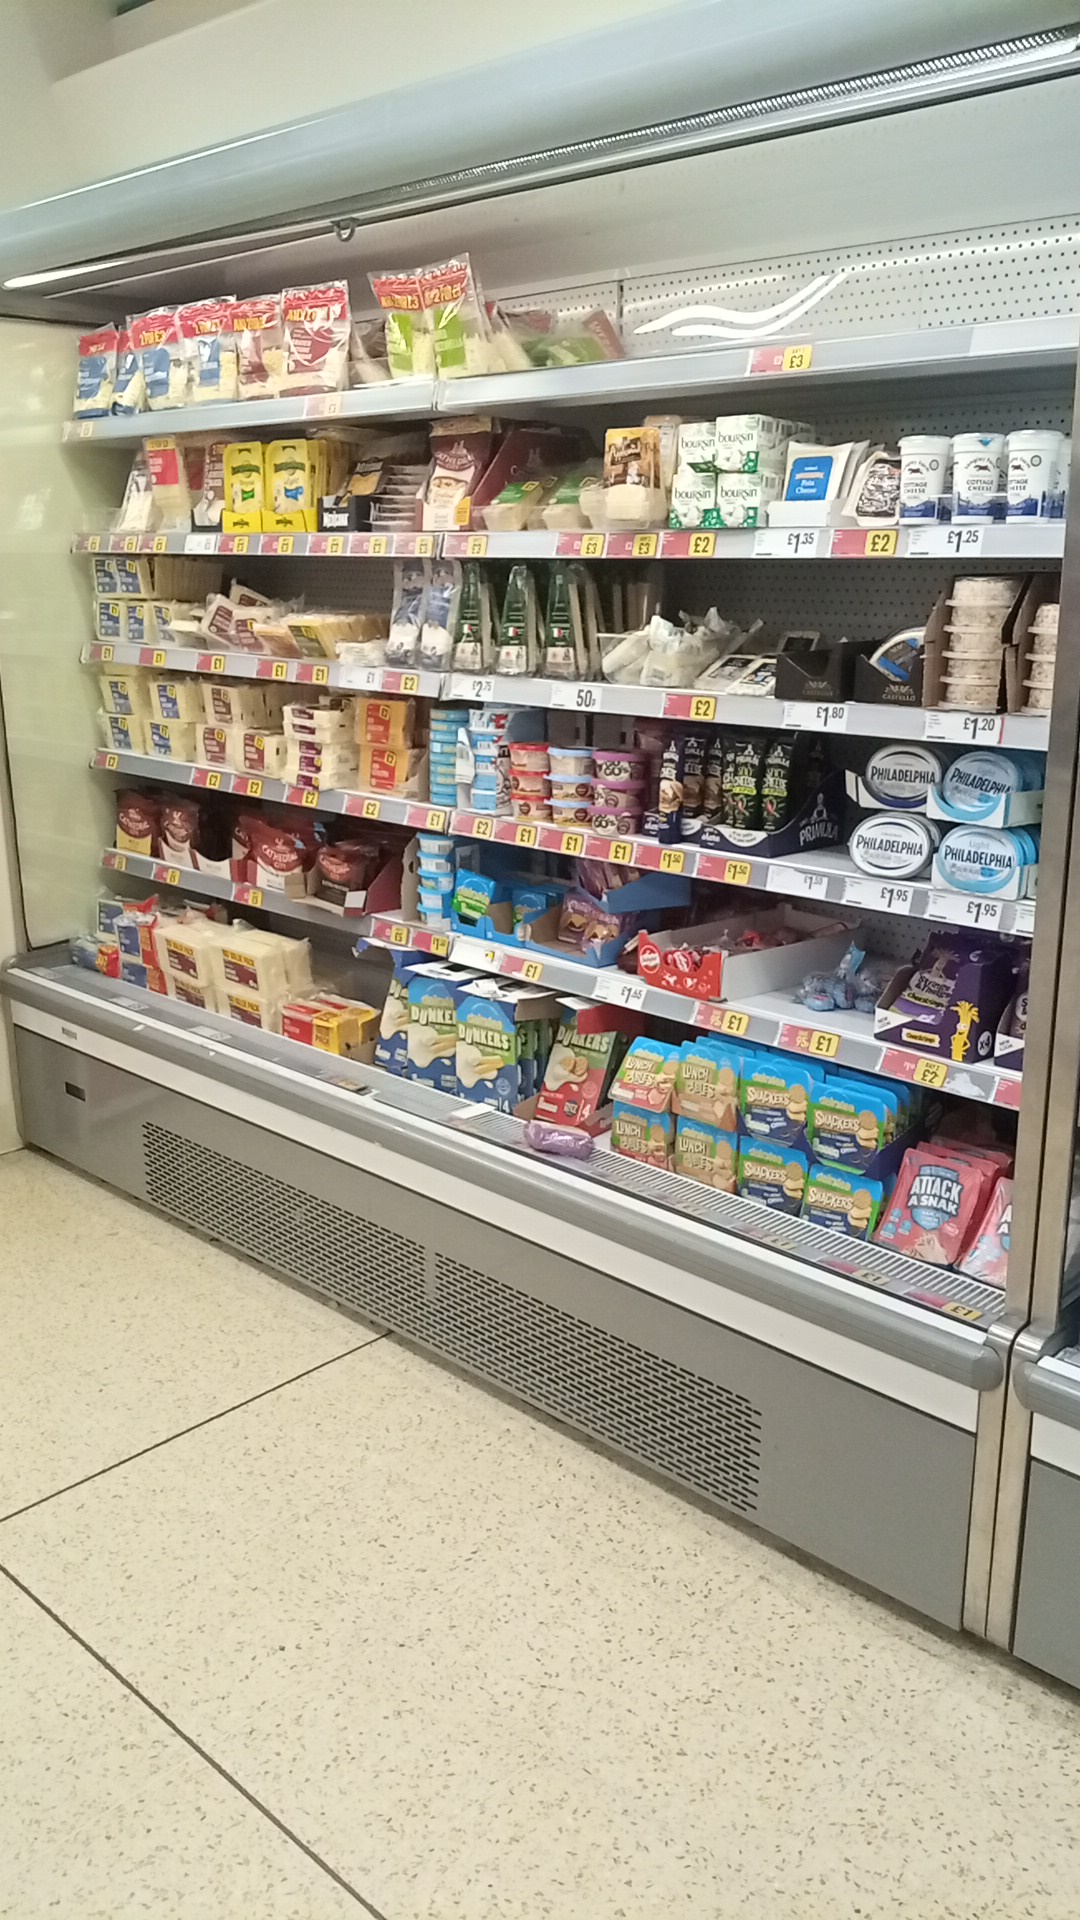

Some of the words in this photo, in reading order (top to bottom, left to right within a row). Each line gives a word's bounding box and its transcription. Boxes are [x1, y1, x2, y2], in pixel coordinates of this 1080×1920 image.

[789, 354, 804, 369] £3
[680, 437, 715, 450] boursin
[717, 429, 754, 444] boursin
[675, 486, 712, 501] boursin
[720, 485, 758, 500] boursin
[585, 543, 597, 554] £3
[638, 543, 650, 554] £3
[693, 537, 711, 553] £2
[787, 532, 815, 554] £1.35
[870, 533, 890, 552] £2
[947, 530, 979, 553] £1.25
[213, 657, 222, 670] £1
[275, 665, 284, 677] £1
[316, 667, 325, 681] £1
[366, 672, 375, 683] £1
[403, 677, 415, 690] £2
[577, 689, 596, 707] 50p
[695, 699, 711, 717] £2
[816, 706, 845, 727] £1.80
[963, 717, 995, 739] £1.20
[208, 774, 218, 787] £2
[870, 767, 936, 785] PHILADELPHIA
[950, 767, 1012, 794] PHILADELPHIA
[250, 782, 259, 794] £2
[305, 793, 316, 807] £2
[365, 803, 377, 816] £2
[430, 813, 440, 827] £1
[476, 821, 489, 835] £2
[520, 829, 531, 843] £1
[800, 821, 839, 847] PRIMULA
[566, 838, 578, 851] £1
[614, 845, 627, 860] £1
[855, 834, 923, 857] PHILADELPHIA
[969, 839, 990, 850] Light
[261, 844, 298, 862] CATHEDRAL
[944, 845, 1013, 870] PHILADELPHIA
[727, 863, 748, 880] £1.50
[881, 887, 909, 908] £1.95
[966, 901, 998, 924] £1.95
[525, 964, 538, 978] £1
[727, 1015, 743, 1031] £1
[458, 1023, 510, 1051] DUNKERS
[557, 1026, 610, 1053] DUNKERS
[815, 1035, 832, 1053] £1
[625, 1058, 653, 1072] LUNCH
[682, 1066, 709, 1083] LUNCH
[921, 1069, 939, 1084] £2
[747, 1087, 790, 1106] SNACKERS
[502, 1100, 510, 1114] 4
[582, 1104, 591, 1121] 4
[815, 1111, 860, 1131] SNACKERS
[615, 1121, 641, 1138] LUNCH
[679, 1137, 707, 1154] LUNCH
[743, 1161, 787, 1182] SNACKERS
[910, 1176, 962, 1204] ATTACK
[808, 1187, 853, 1210] SNACKERS
[907, 1195, 918, 1206] A
[919, 1195, 958, 1215] SNAK
[860, 1272, 881, 1283] £1
[950, 1306, 972, 1318] £1
